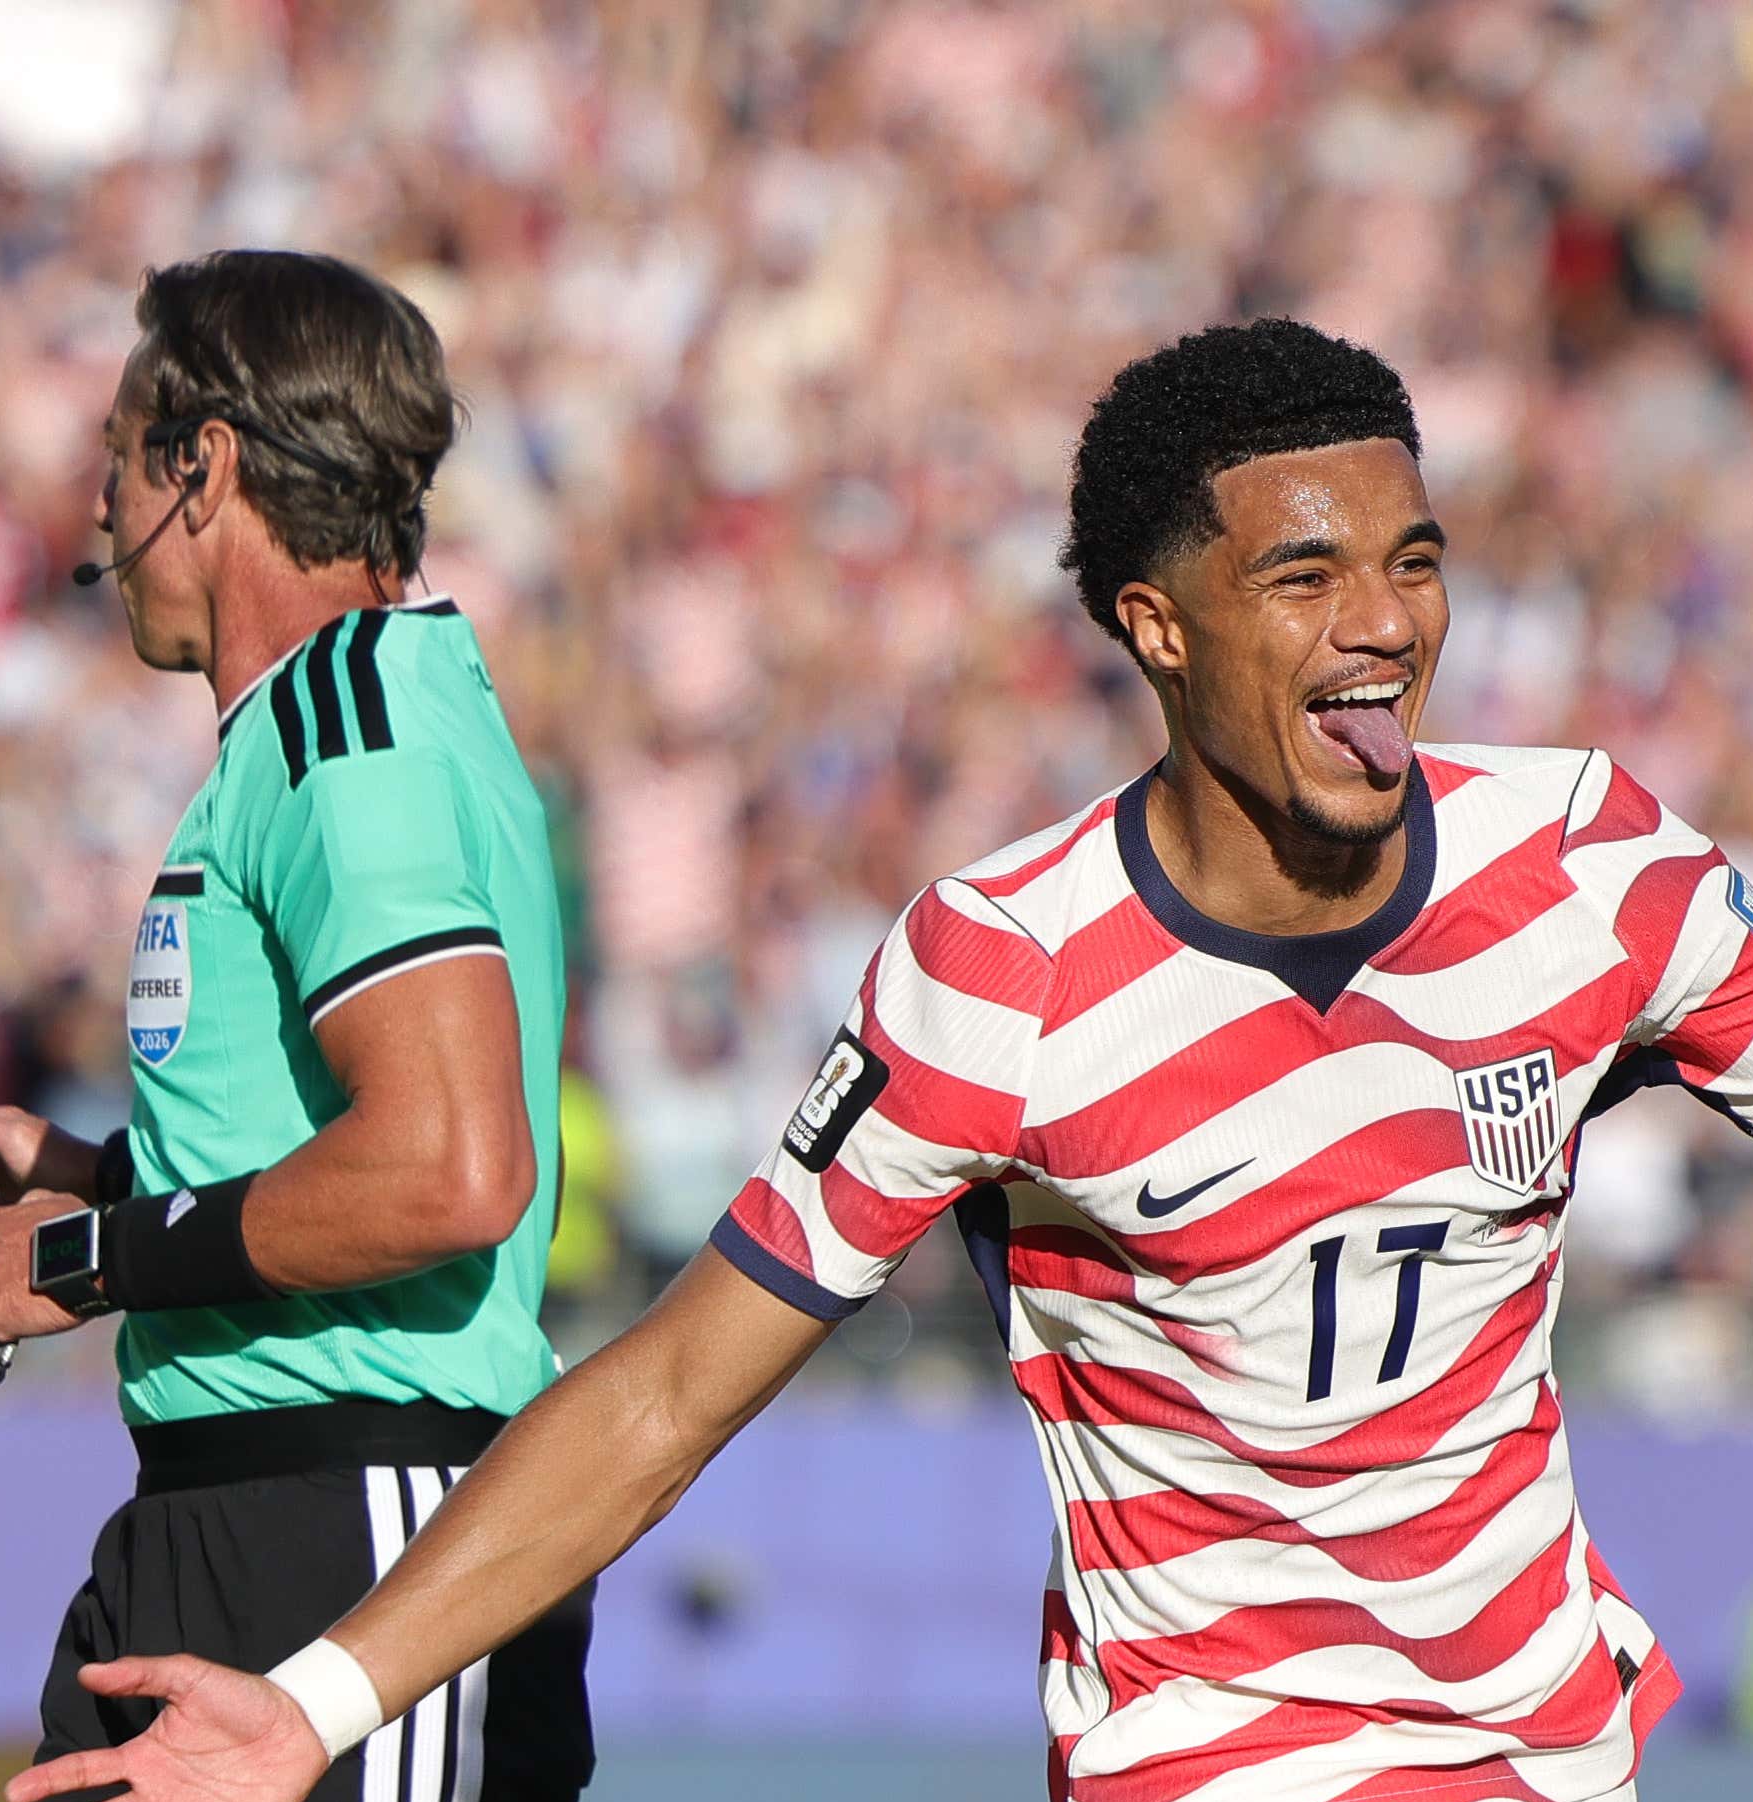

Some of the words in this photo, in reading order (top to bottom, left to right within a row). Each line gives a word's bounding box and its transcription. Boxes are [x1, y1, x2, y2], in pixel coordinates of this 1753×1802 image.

[139, 1031, 170, 1050] 2026
[1464, 1058, 1549, 1118] USA
[1307, 1220, 1452, 1403] 17
